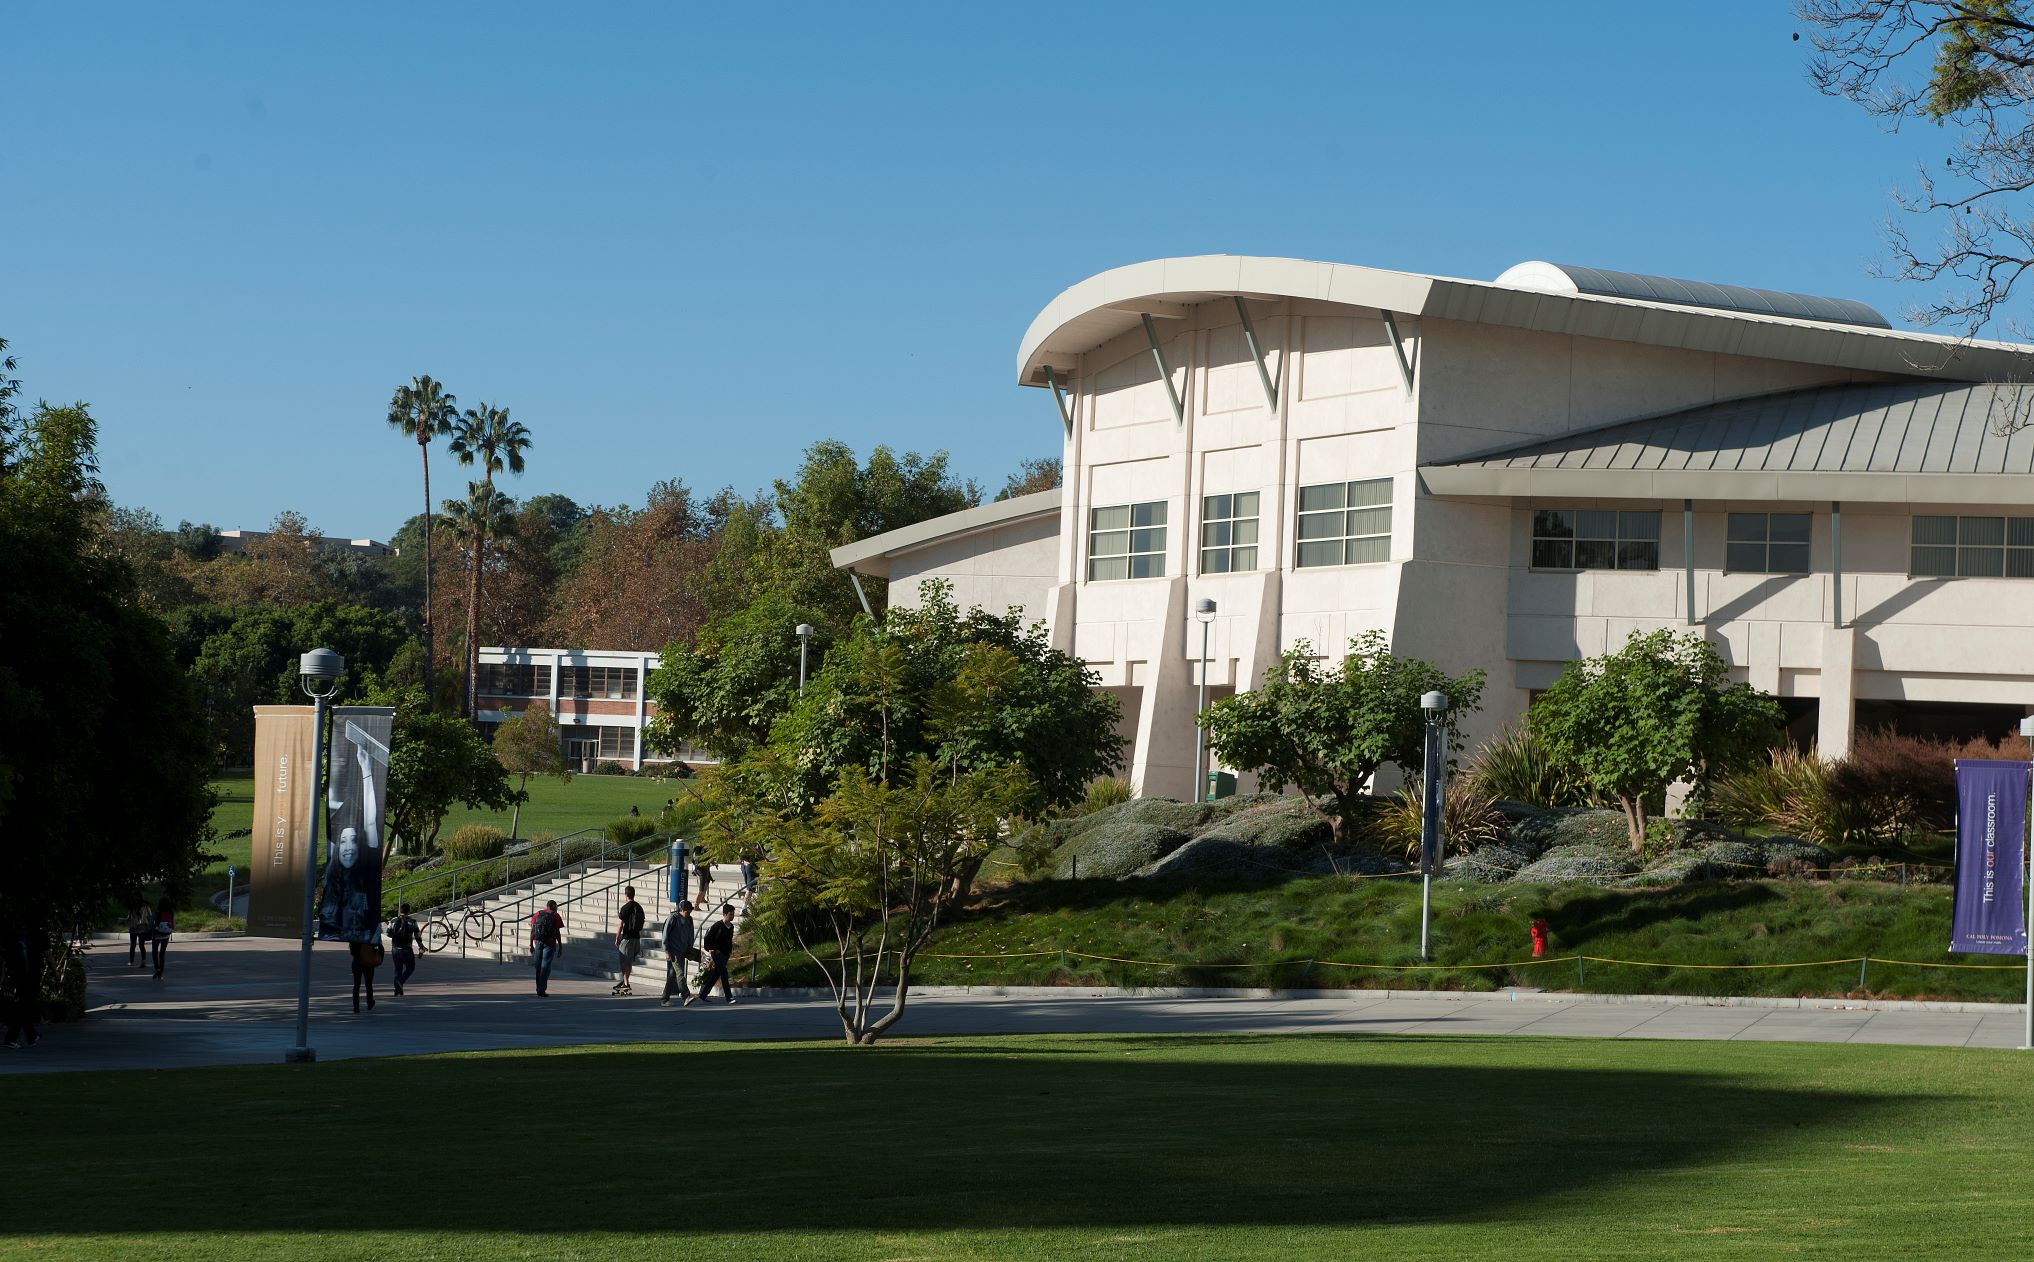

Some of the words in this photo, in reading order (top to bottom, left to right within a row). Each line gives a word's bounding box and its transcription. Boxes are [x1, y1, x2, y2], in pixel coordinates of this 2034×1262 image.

[276, 754, 288, 792] future.
[1985, 792, 1996, 847] classroom.
[275, 828, 285, 838] is
[274, 842, 283, 868] This
[1986, 849, 1995, 867] our
[1984, 870, 1995, 879] is
[1983, 882, 1994, 903] This
